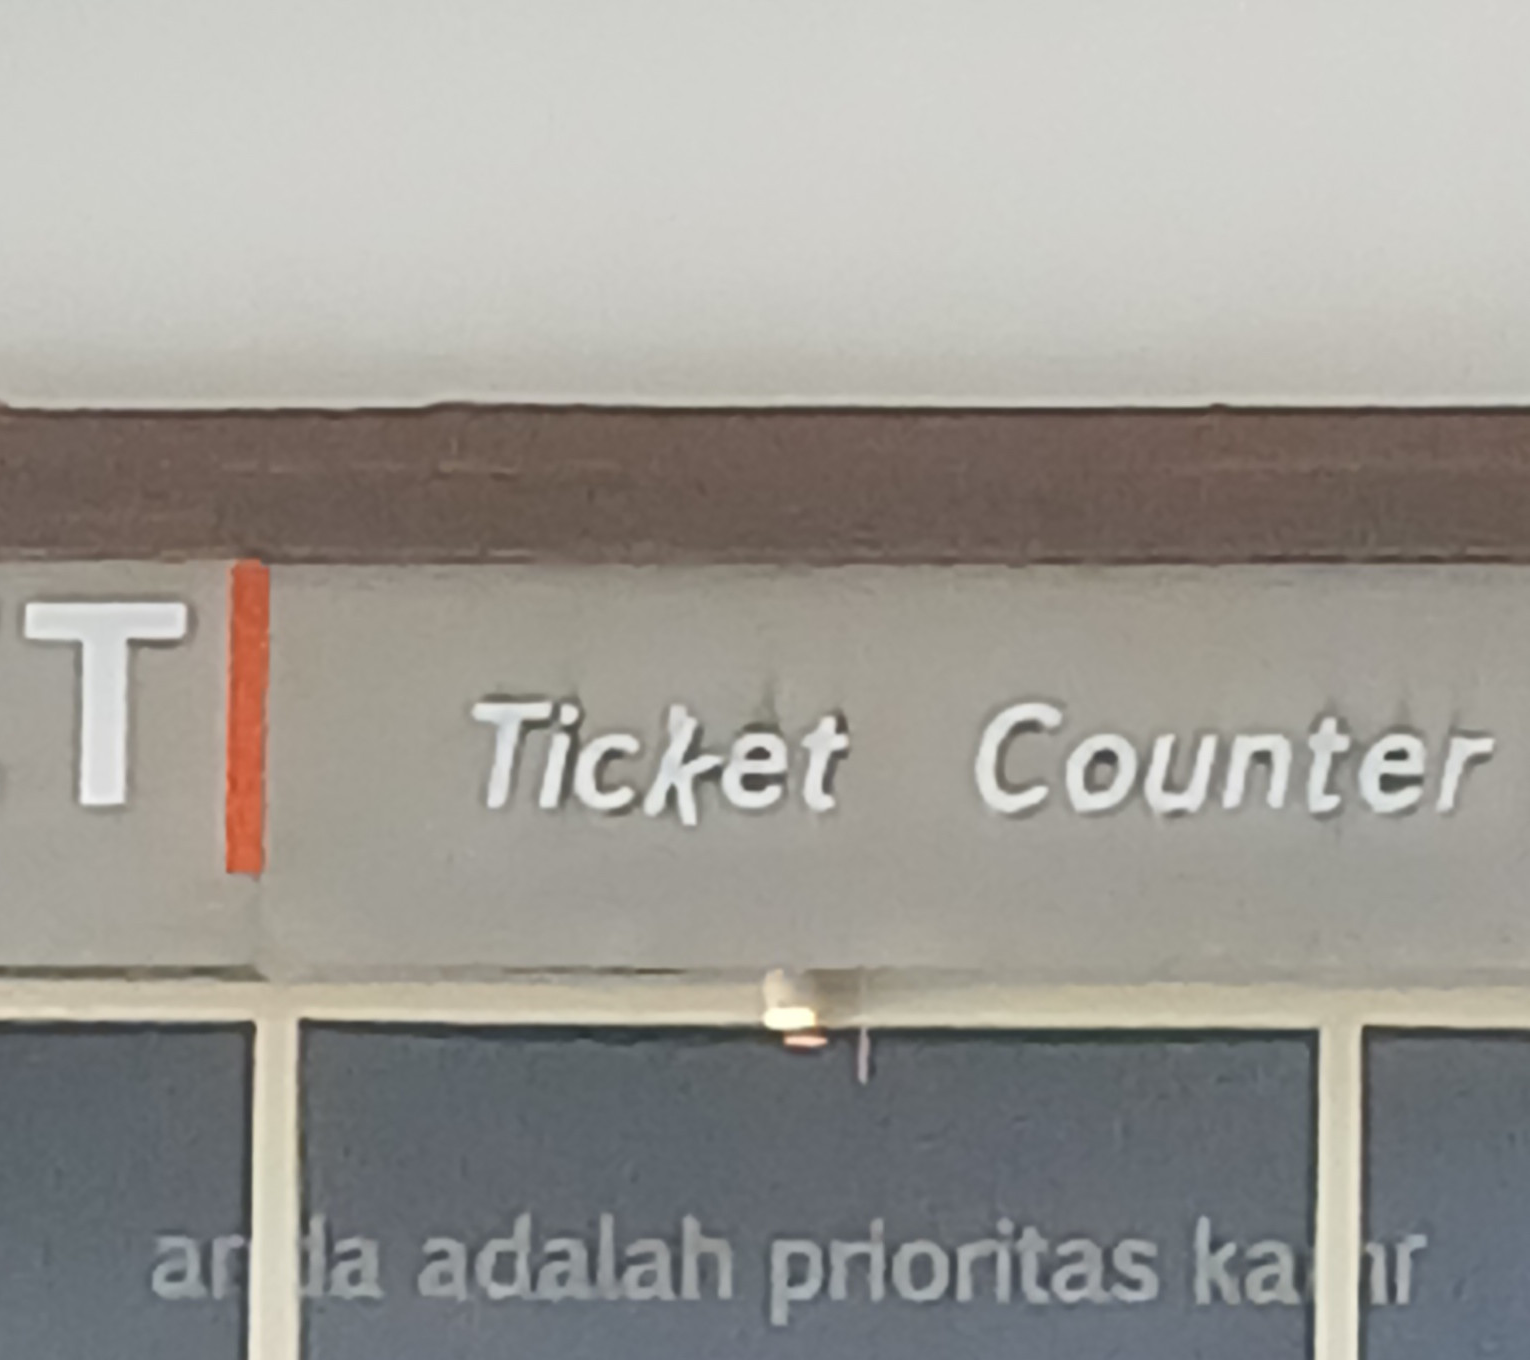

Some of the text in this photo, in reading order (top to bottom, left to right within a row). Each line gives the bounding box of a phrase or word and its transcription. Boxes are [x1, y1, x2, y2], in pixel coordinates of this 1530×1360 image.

[472, 701, 1495, 826] Ticket Counter
[417, 1212, 733, 1301] adalah
[771, 1217, 1159, 1326] prioritas
